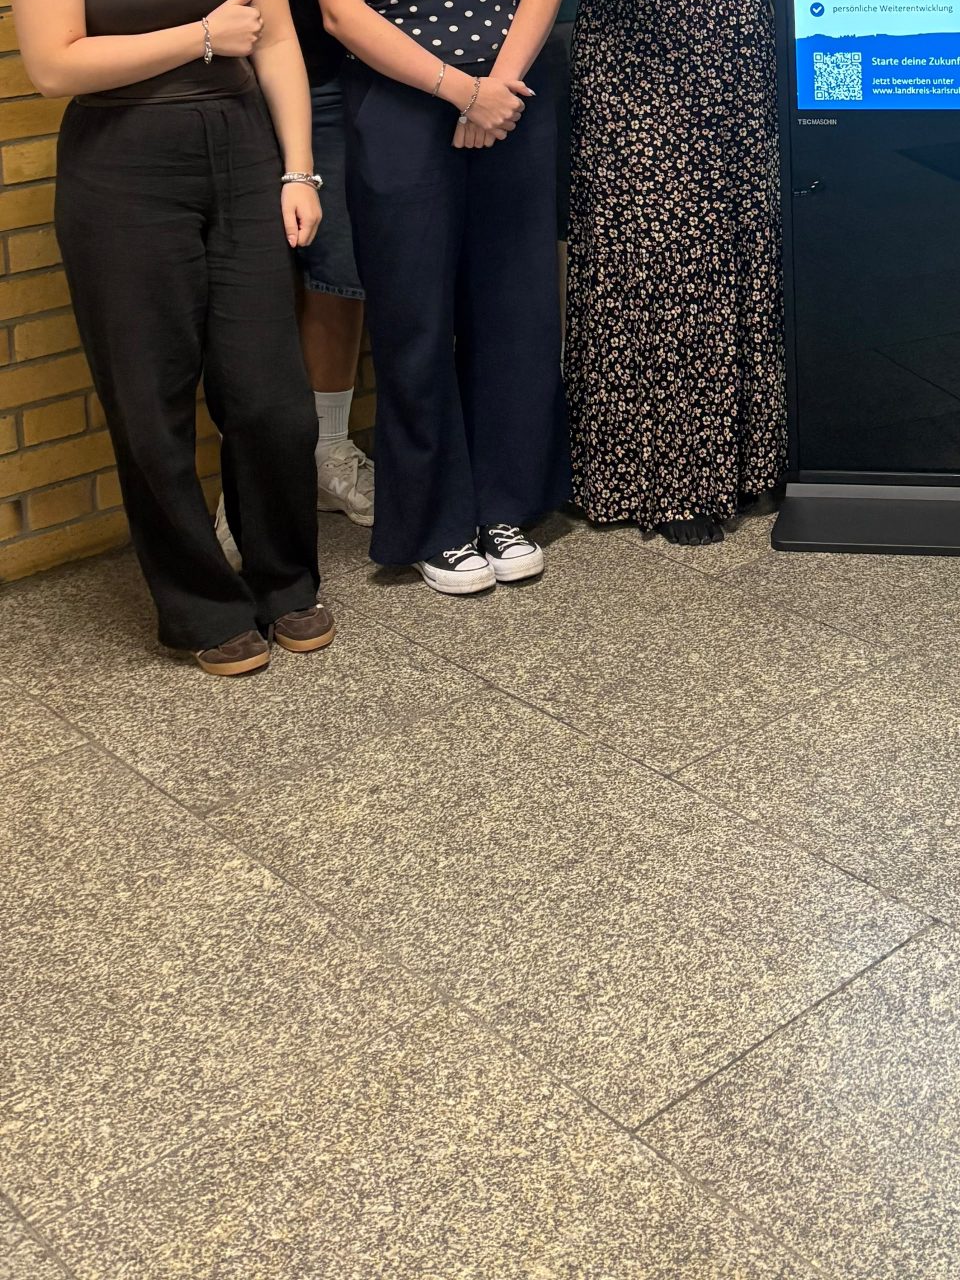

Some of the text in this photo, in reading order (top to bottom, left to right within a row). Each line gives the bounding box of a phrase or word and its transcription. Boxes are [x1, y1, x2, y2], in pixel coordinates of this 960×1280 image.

[832, 4, 953, 14] persönliche Weiterentwicklung
[872, 56, 899, 66] Starte
[902, 56, 927, 66] deine
[872, 77, 890, 85] Jetzt
[892, 77, 930, 85] bewerben
